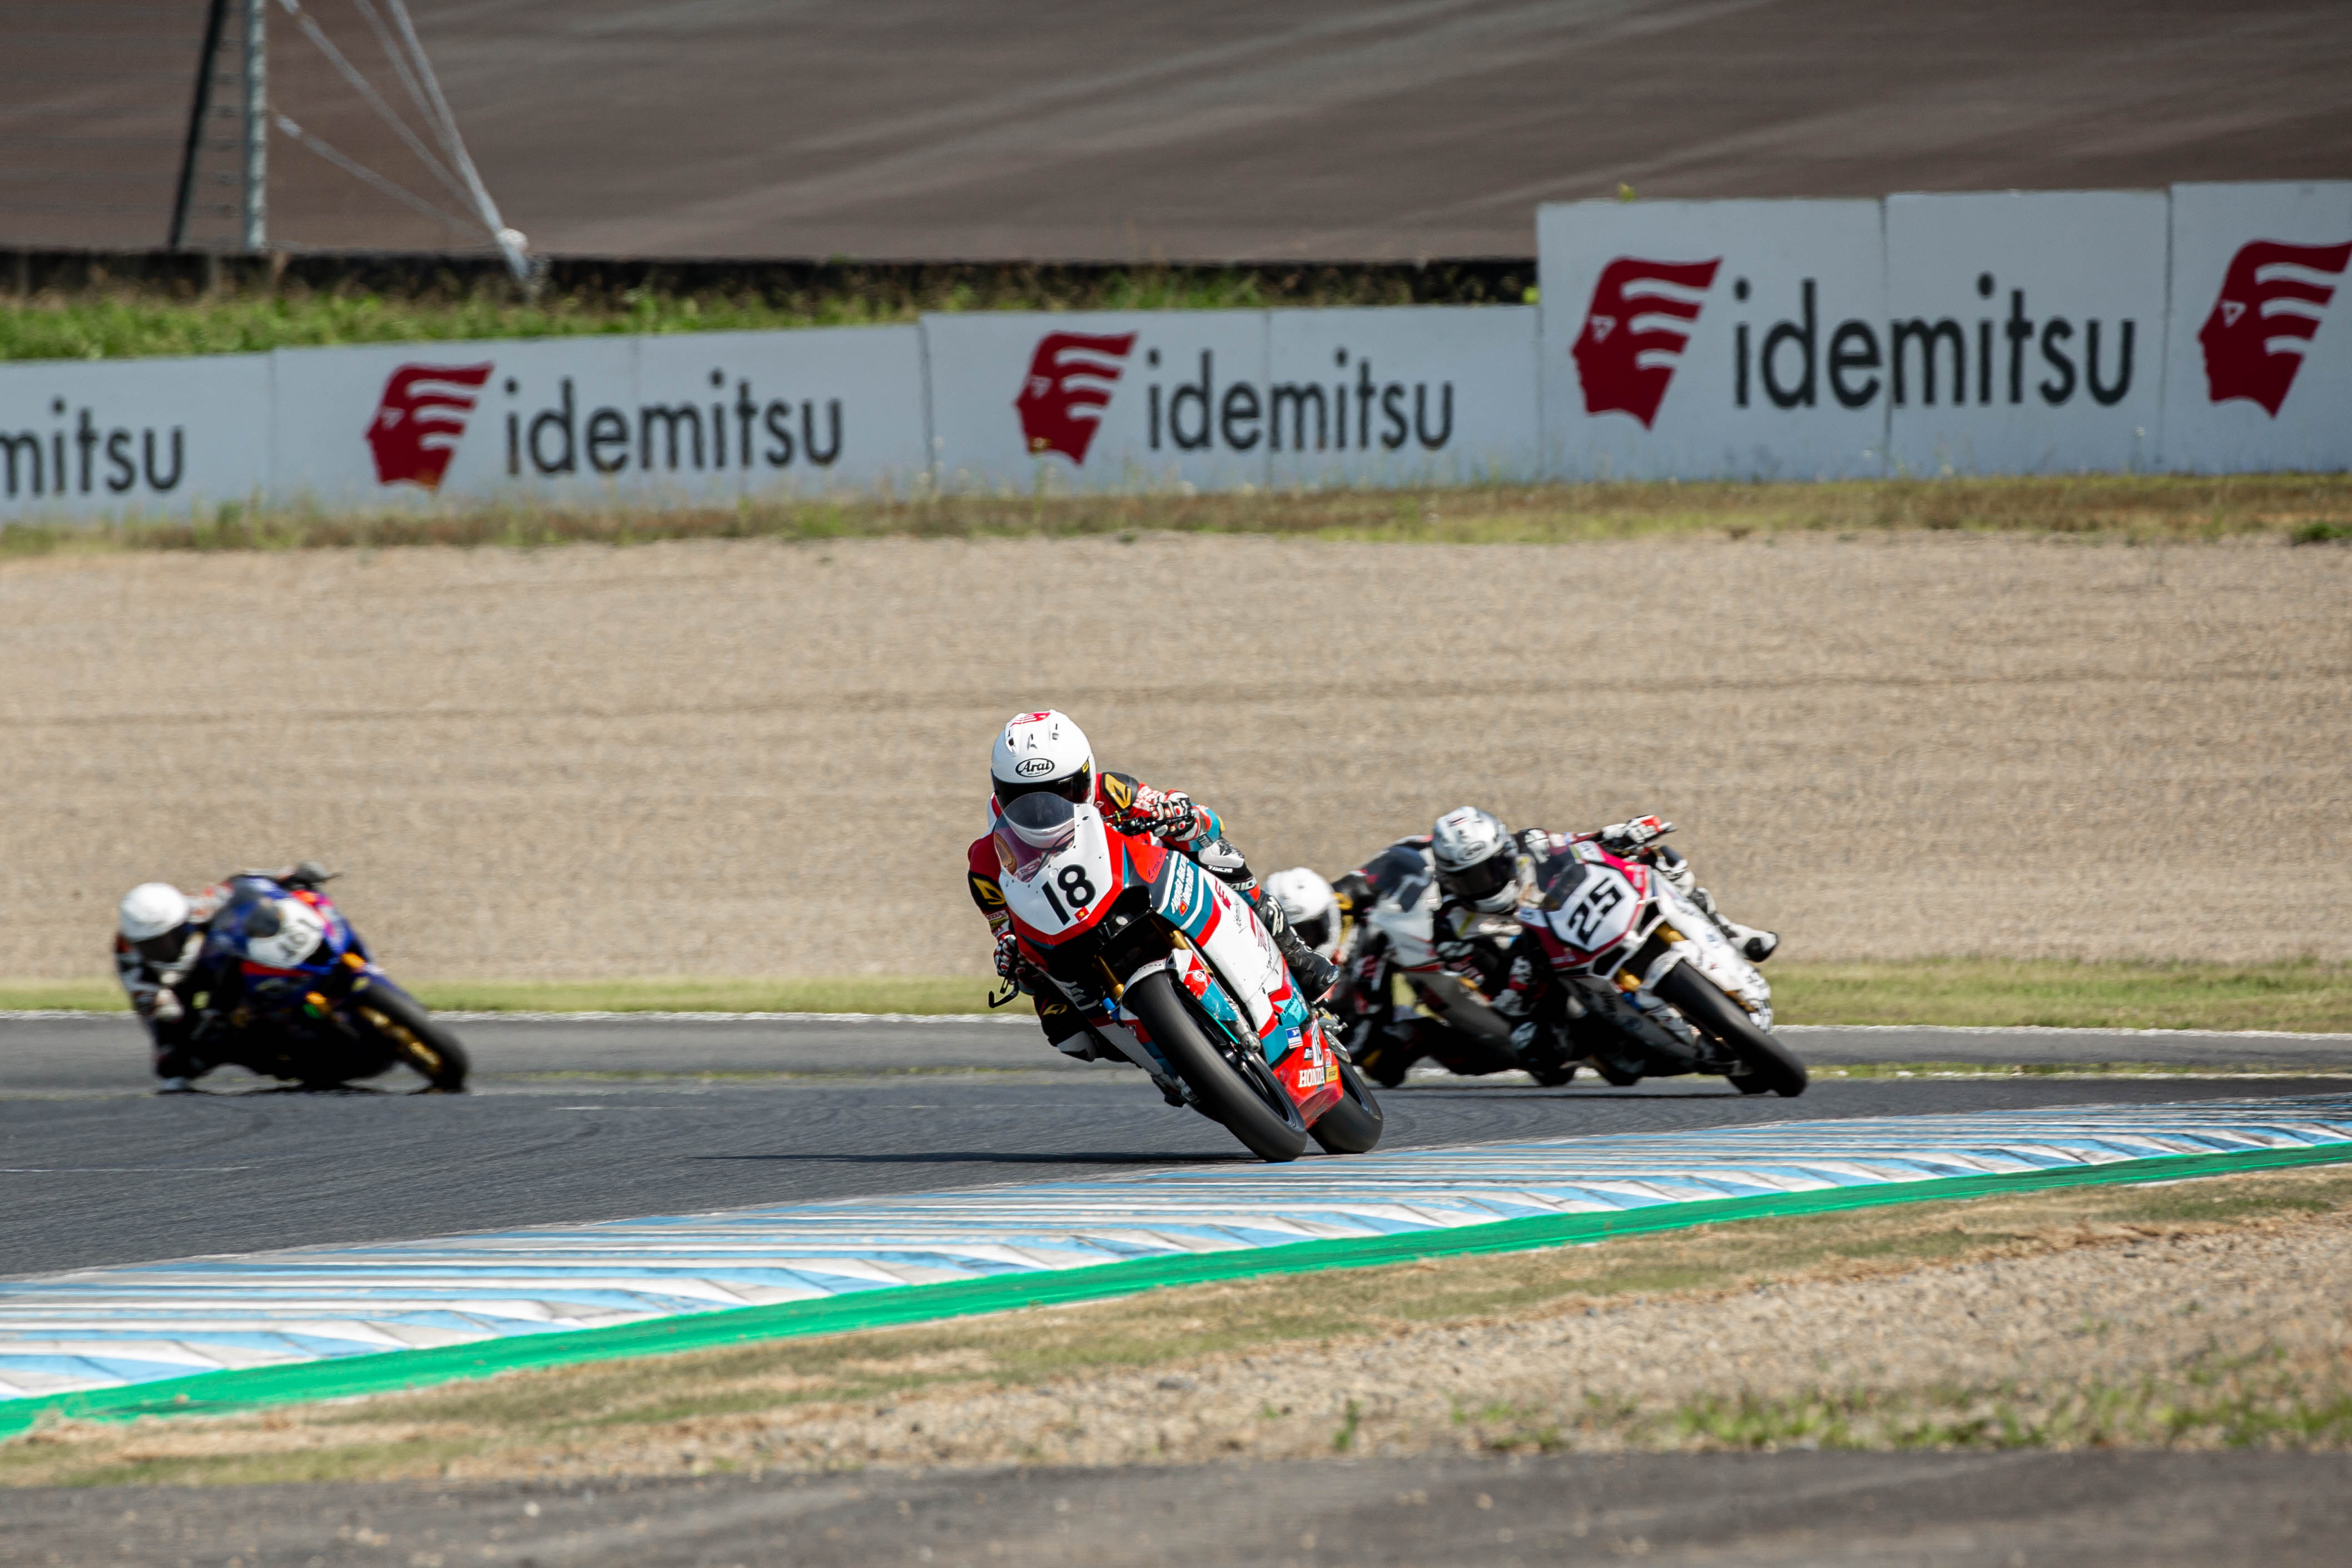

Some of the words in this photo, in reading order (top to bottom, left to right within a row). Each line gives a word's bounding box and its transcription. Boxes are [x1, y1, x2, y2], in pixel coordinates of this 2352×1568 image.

[1732, 270, 2138, 410] idemitsu
[503, 369, 843, 479] idemitsu
[1145, 346, 1455, 455] idemitsu
[1018, 760, 1051, 773] Arai
[1041, 864, 1095, 926] 18
[1567, 876, 1622, 945] 25
[1298, 1066, 1326, 1088] HONDA
